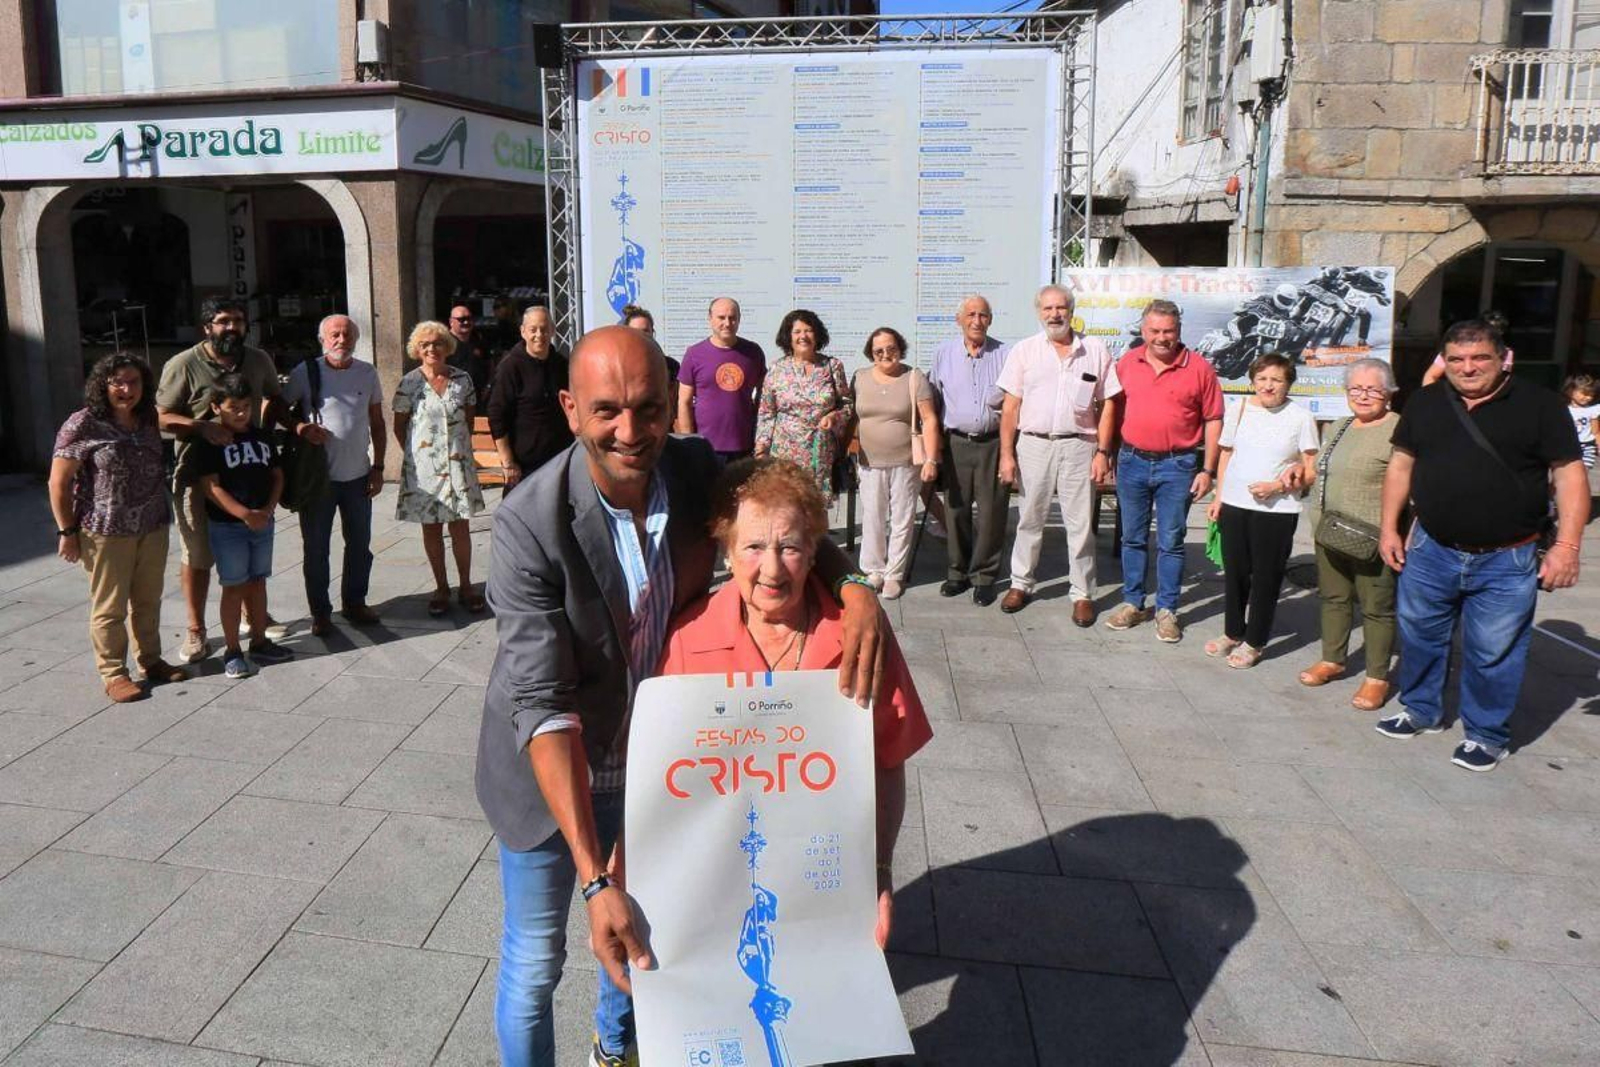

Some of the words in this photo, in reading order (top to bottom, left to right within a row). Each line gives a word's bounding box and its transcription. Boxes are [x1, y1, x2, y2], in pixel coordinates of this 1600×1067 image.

[137, 120, 282, 161] Parada
[298, 130, 381, 154] Limite
[748, 700, 757, 711] O
[759, 699, 793, 711] Porriño
[695, 727, 766, 747] FESTAS
[775, 725, 805, 743] DO
[665, 751, 837, 799] CRISTO
[824, 846, 840, 855] set
[805, 870, 818, 879] de
[822, 868, 840, 878] out
[814, 880, 840, 889] 2023
